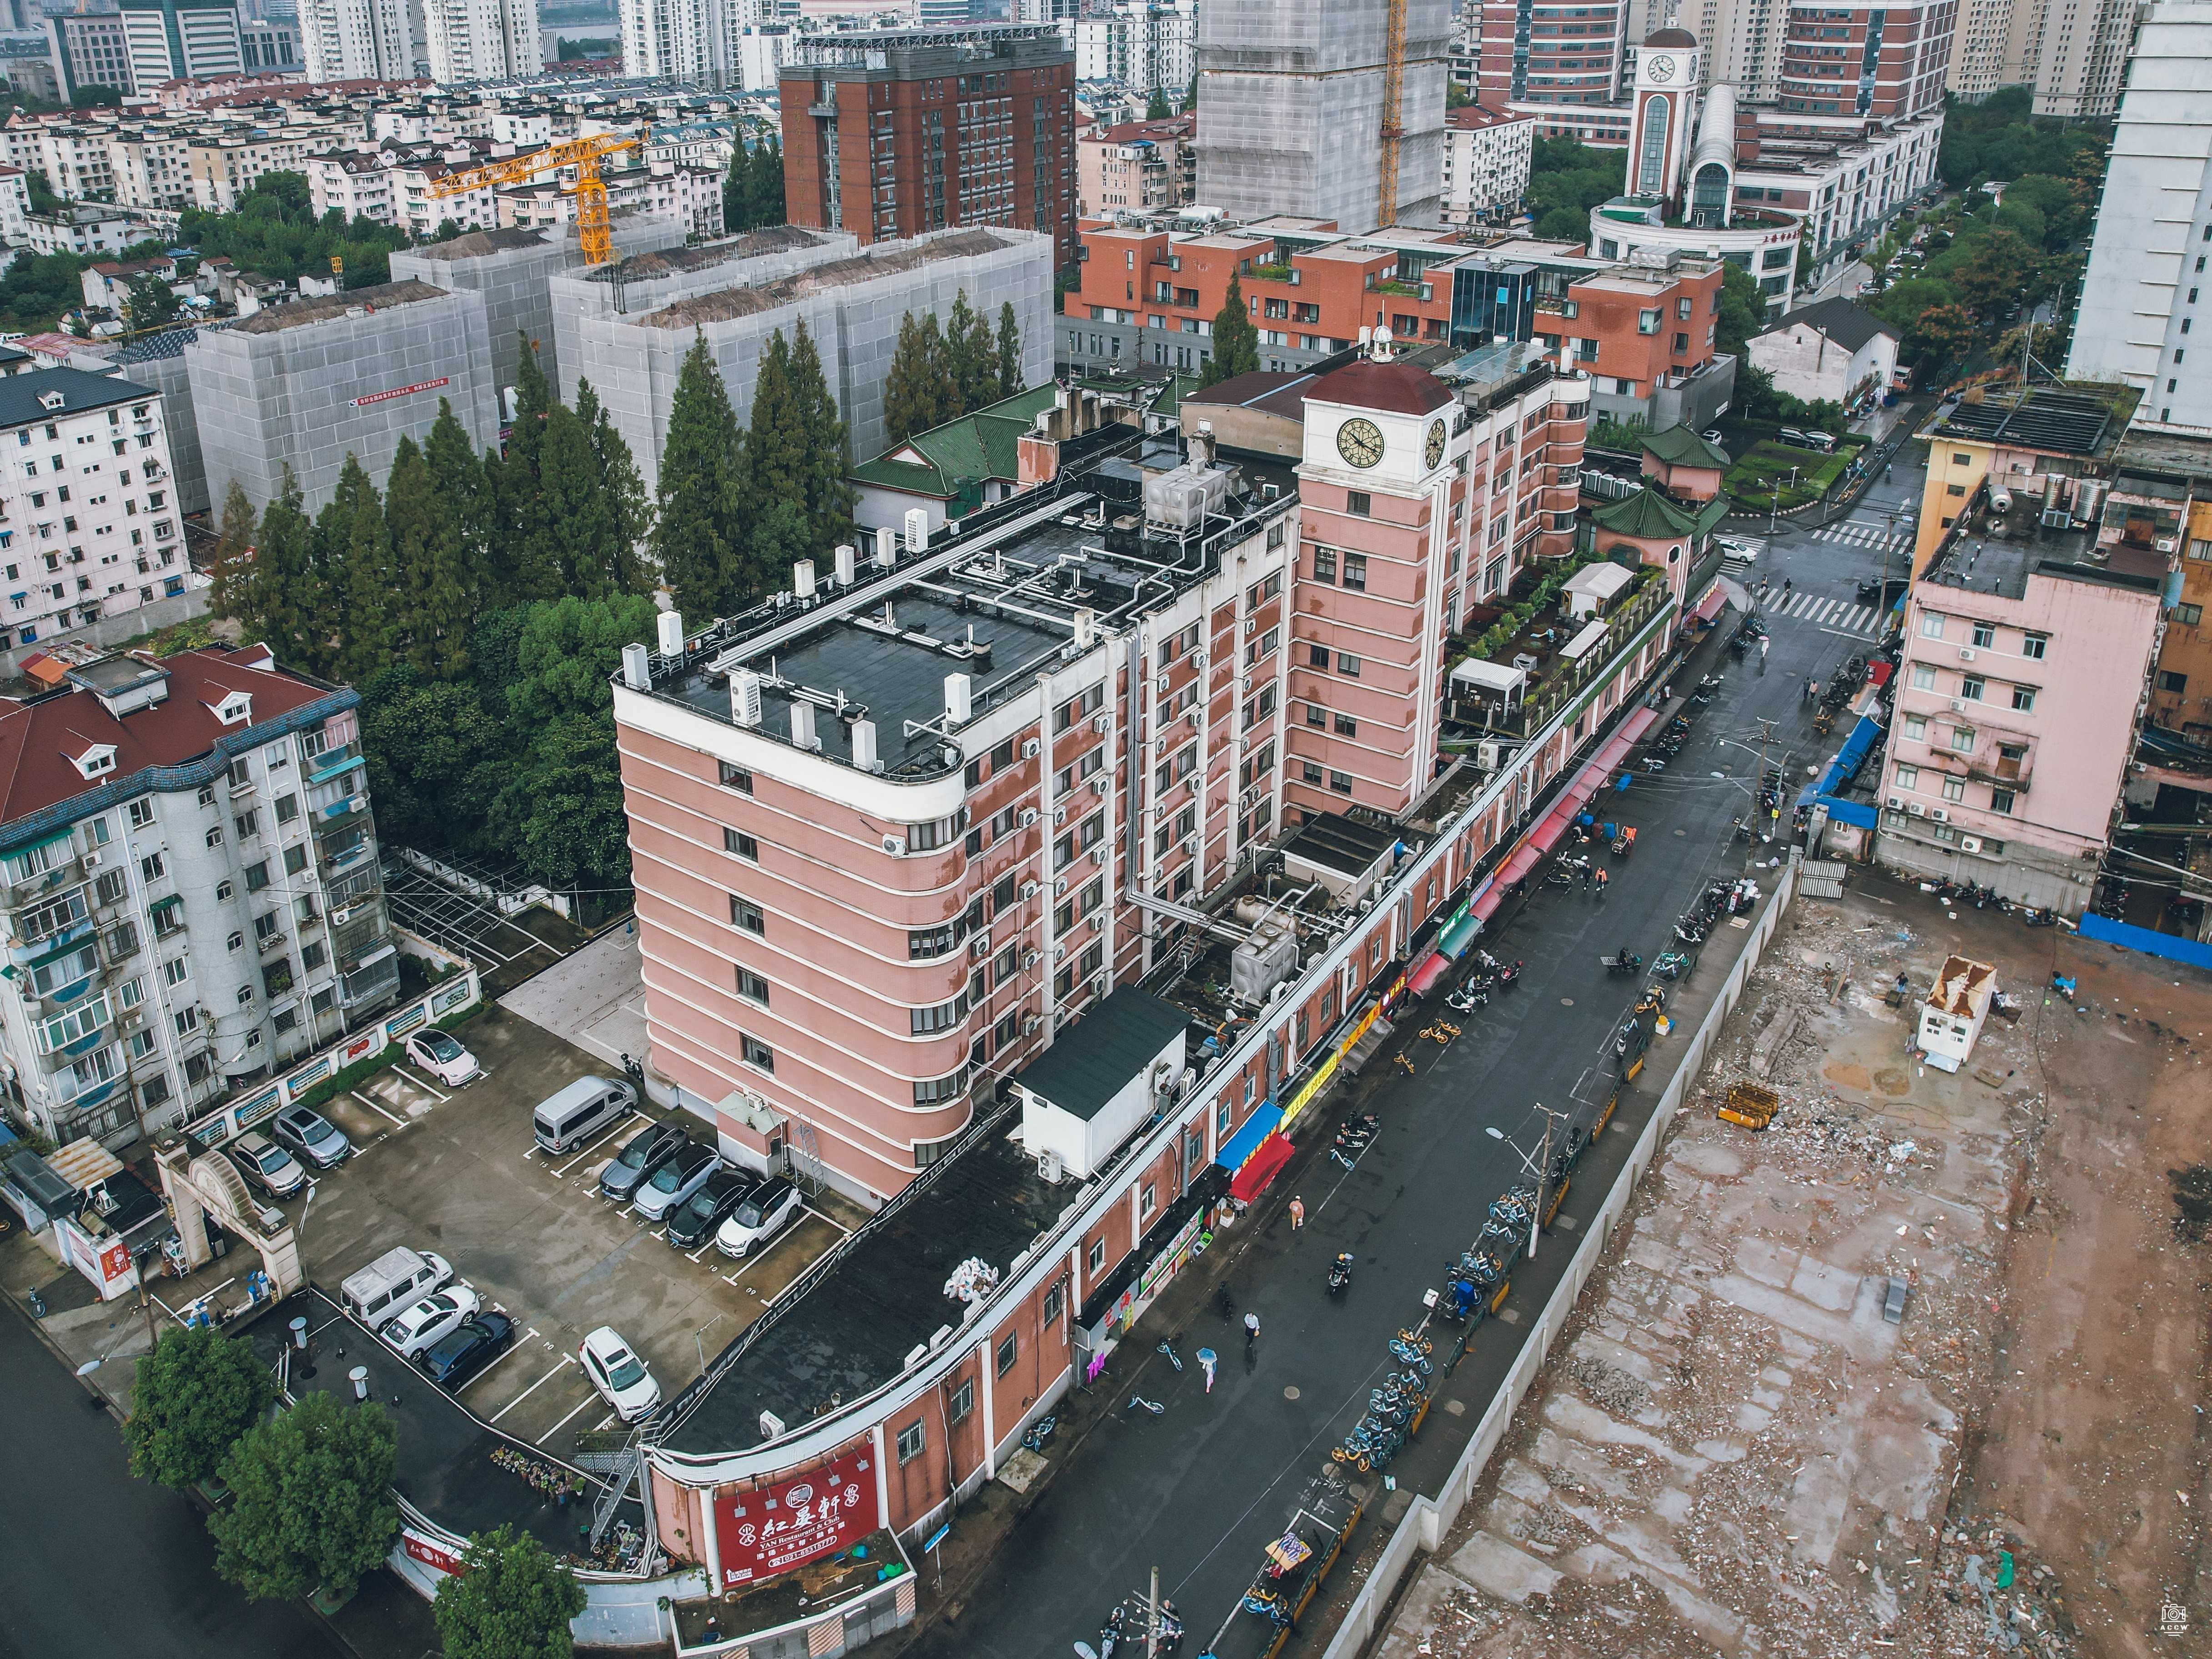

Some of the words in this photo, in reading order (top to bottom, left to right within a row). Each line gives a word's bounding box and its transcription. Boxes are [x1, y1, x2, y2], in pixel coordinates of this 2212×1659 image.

[510, 1317, 521, 1326] 03
[543, 1341, 554, 1350] 04
[759, 1539, 777, 1550] YAN
[778, 1526, 815, 1544] Restaurant
[824, 1515, 840, 1527] Club
